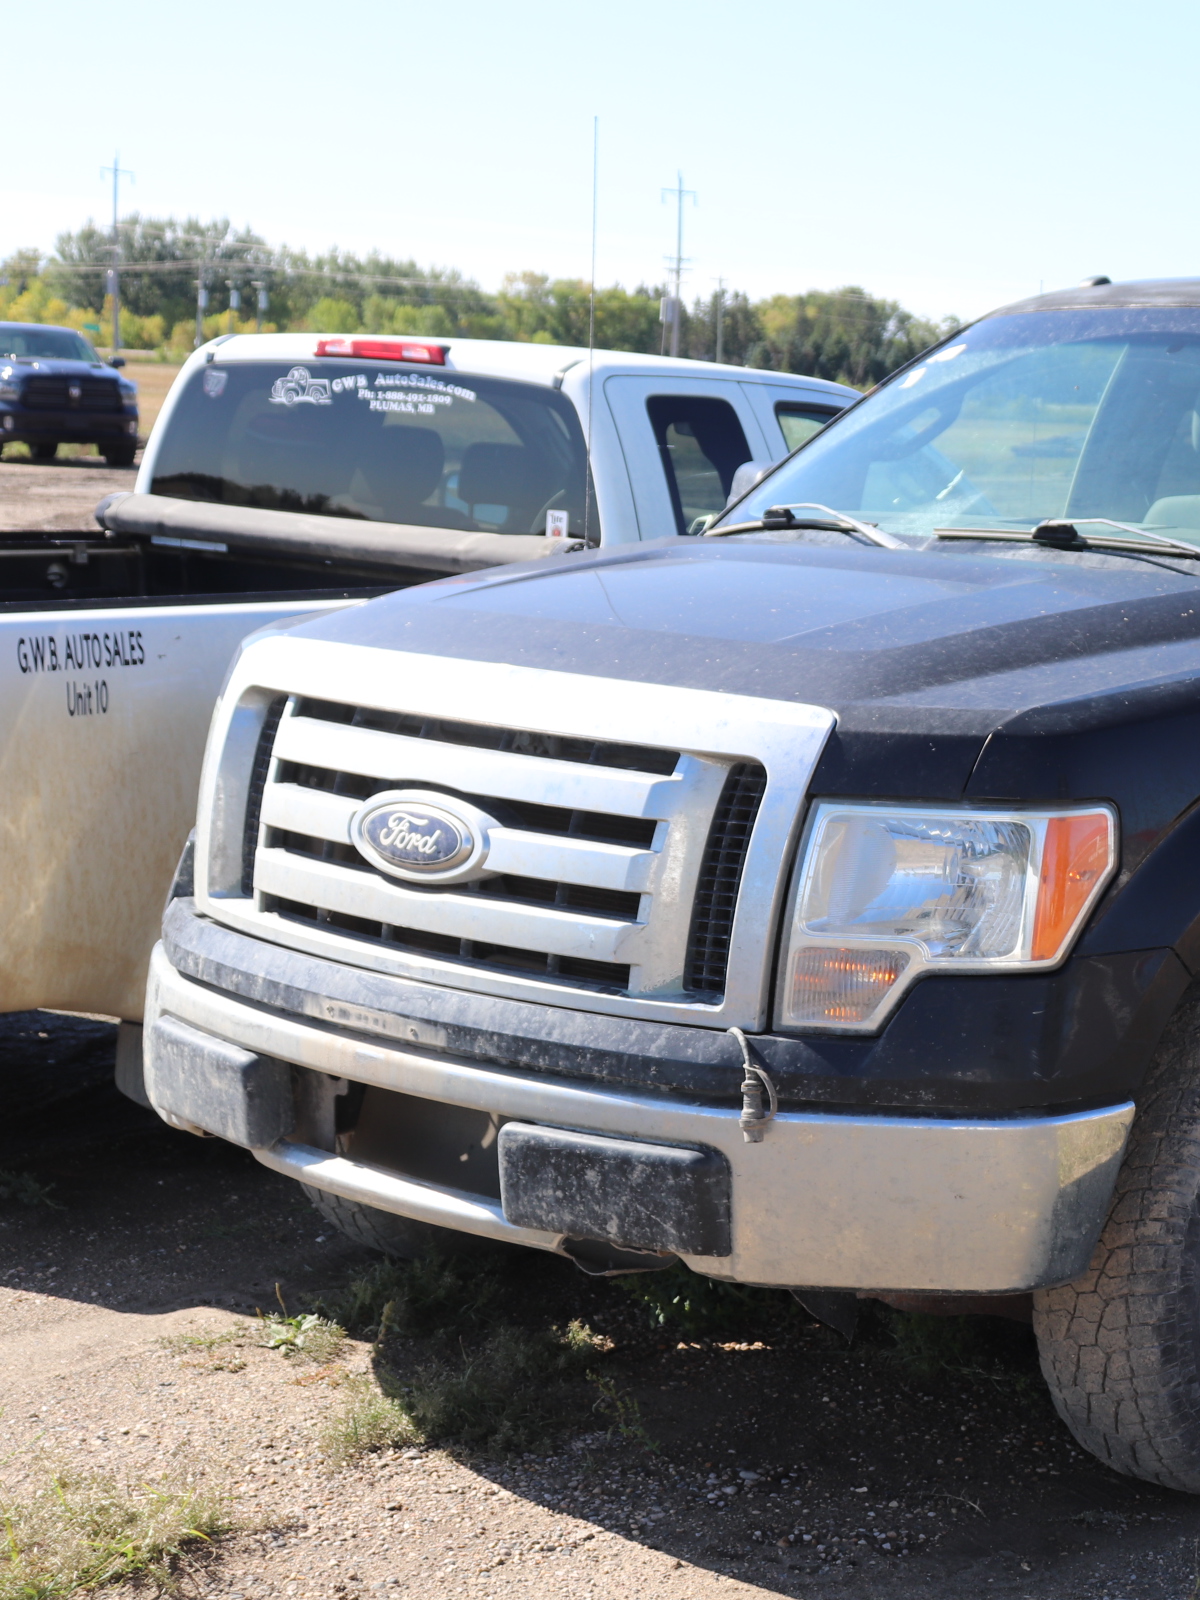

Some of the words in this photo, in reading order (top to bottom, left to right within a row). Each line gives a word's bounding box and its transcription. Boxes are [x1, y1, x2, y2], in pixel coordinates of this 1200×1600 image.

[332, 374, 368, 393] GWB
[375, 373, 476, 402] AutoSales.com
[358, 388, 376, 400] Ph:
[377, 390, 452, 405] 1-888-491-1809
[369, 400, 416, 415] PLUMAS,
[417, 403, 435, 414] MB
[17, 635, 61, 673] G.W.B.
[65, 633, 101, 670] AUTO
[104, 630, 145, 667] SALES
[66, 680, 92, 716] Unit
[95, 679, 109, 713] 10
[380, 812, 442, 855] Ford
